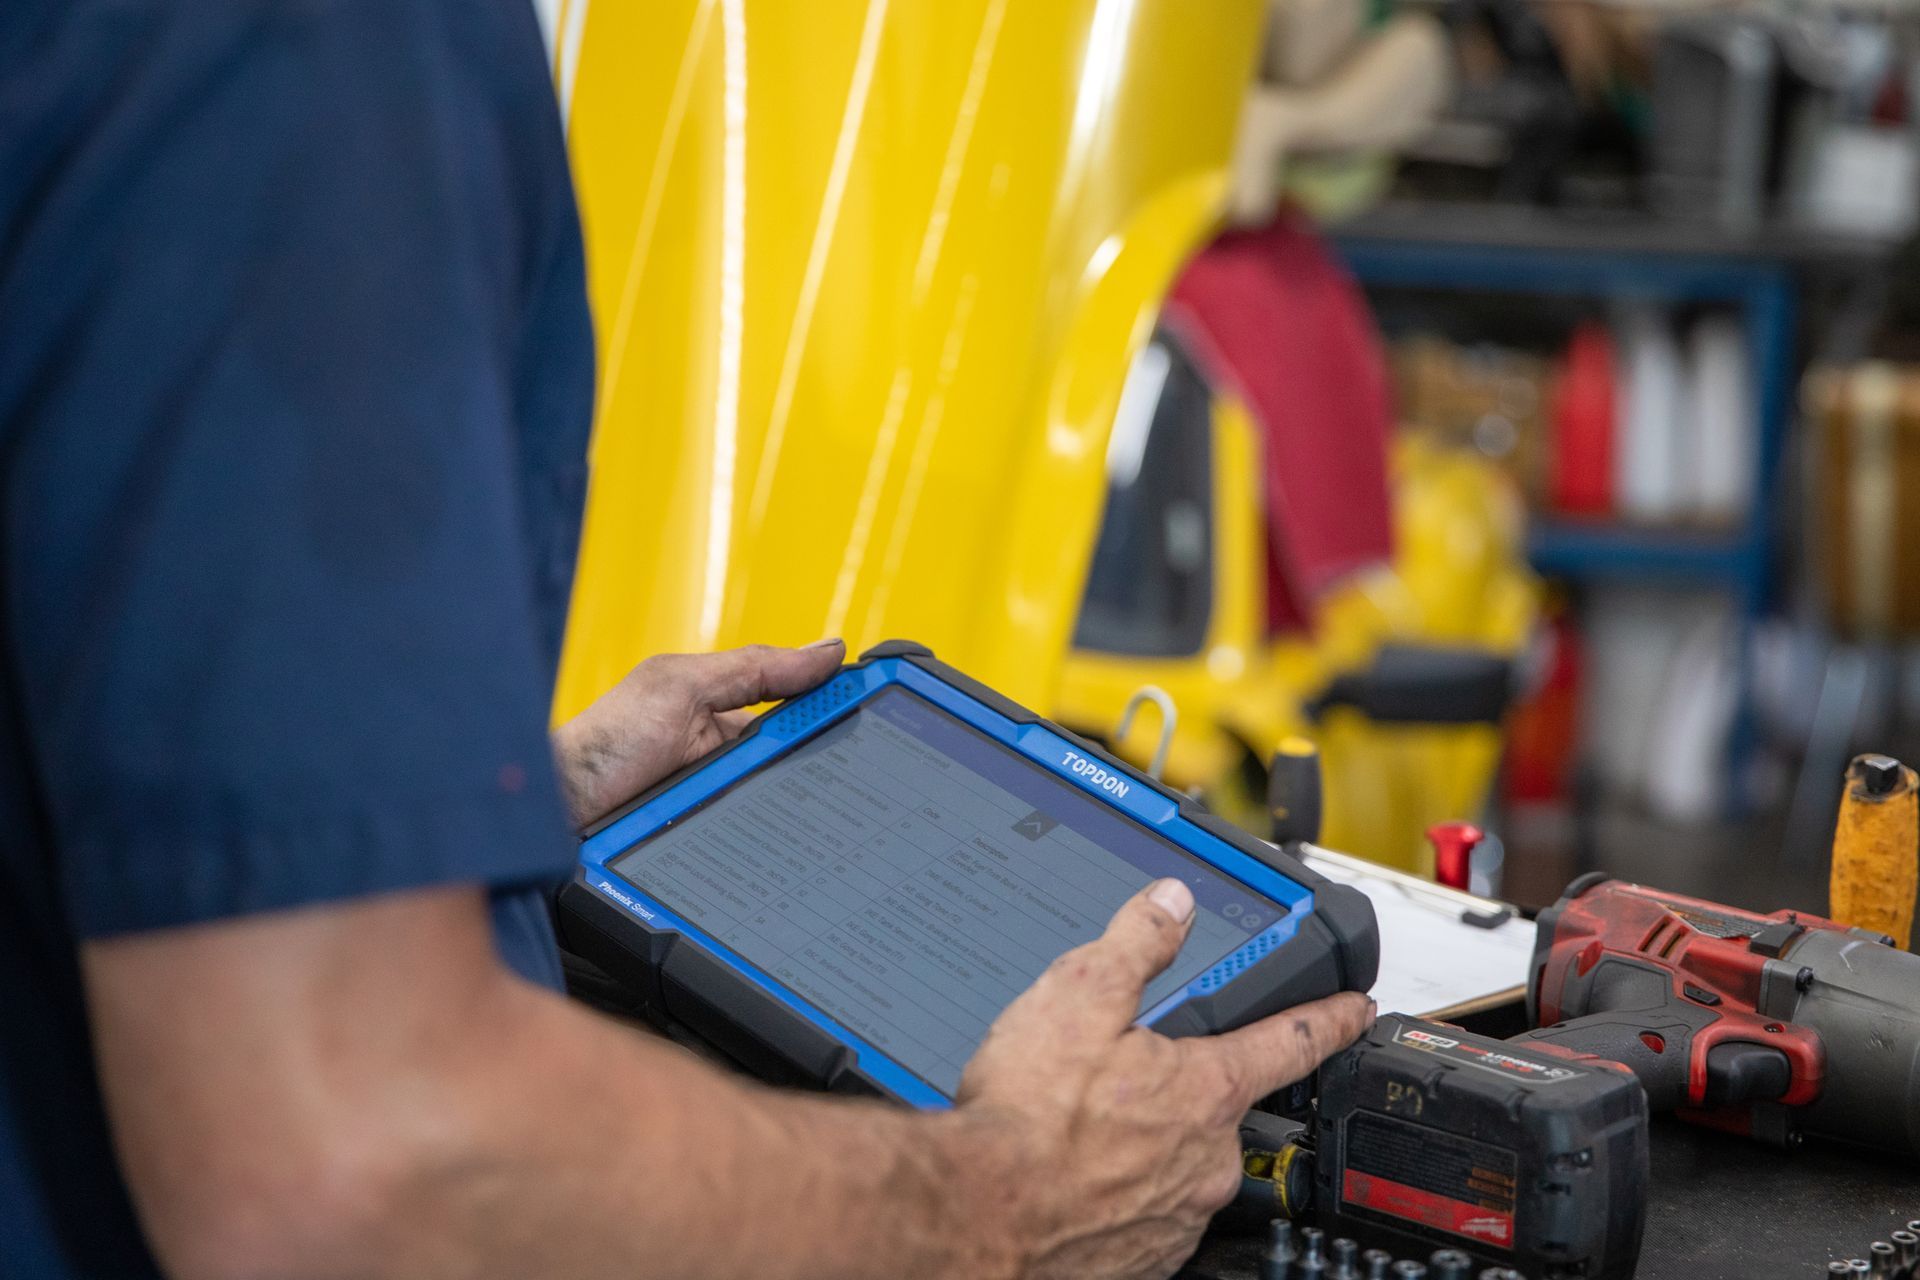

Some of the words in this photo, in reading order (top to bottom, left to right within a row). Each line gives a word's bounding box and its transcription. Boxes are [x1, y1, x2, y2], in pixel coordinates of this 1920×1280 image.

[1061, 751, 1130, 799] TOPDON
[841, 781, 869, 798] Control
[863, 794, 891, 811] Module
[816, 797, 843, 814] Control
[838, 811, 865, 828] Module
[920, 806, 942, 820] Code
[777, 829, 804, 846] Cluster
[795, 817, 823, 835] Cluster
[740, 853, 766, 870] Cluster
[758, 841, 785, 858] Cluster
[969, 837, 1011, 862] Description
[721, 865, 747, 882] Cluster
[944, 854, 979, 876] Exceeded
[700, 877, 729, 896] Braking
[969, 859, 989, 871] Fuel
[998, 877, 1020, 890] Bank
[1021, 891, 1063, 917] Permissible
[1056, 913, 1084, 930] Range
[598, 881, 634, 907] Phoenix
[631, 903, 656, 921] Smart
[911, 891, 935, 906] Gong
[930, 902, 951, 915] Tone
[960, 893, 995, 915] Cylinder
[855, 928, 879, 944] Gong
[873, 939, 895, 953] Tone
[875, 916, 896, 929] Tank
[890, 925, 918, 943] Sensor
[836, 941, 860, 957] Gong
[855, 952, 876, 966] Tone
[817, 958, 838, 971] Brief
[832, 967, 857, 984] Power
